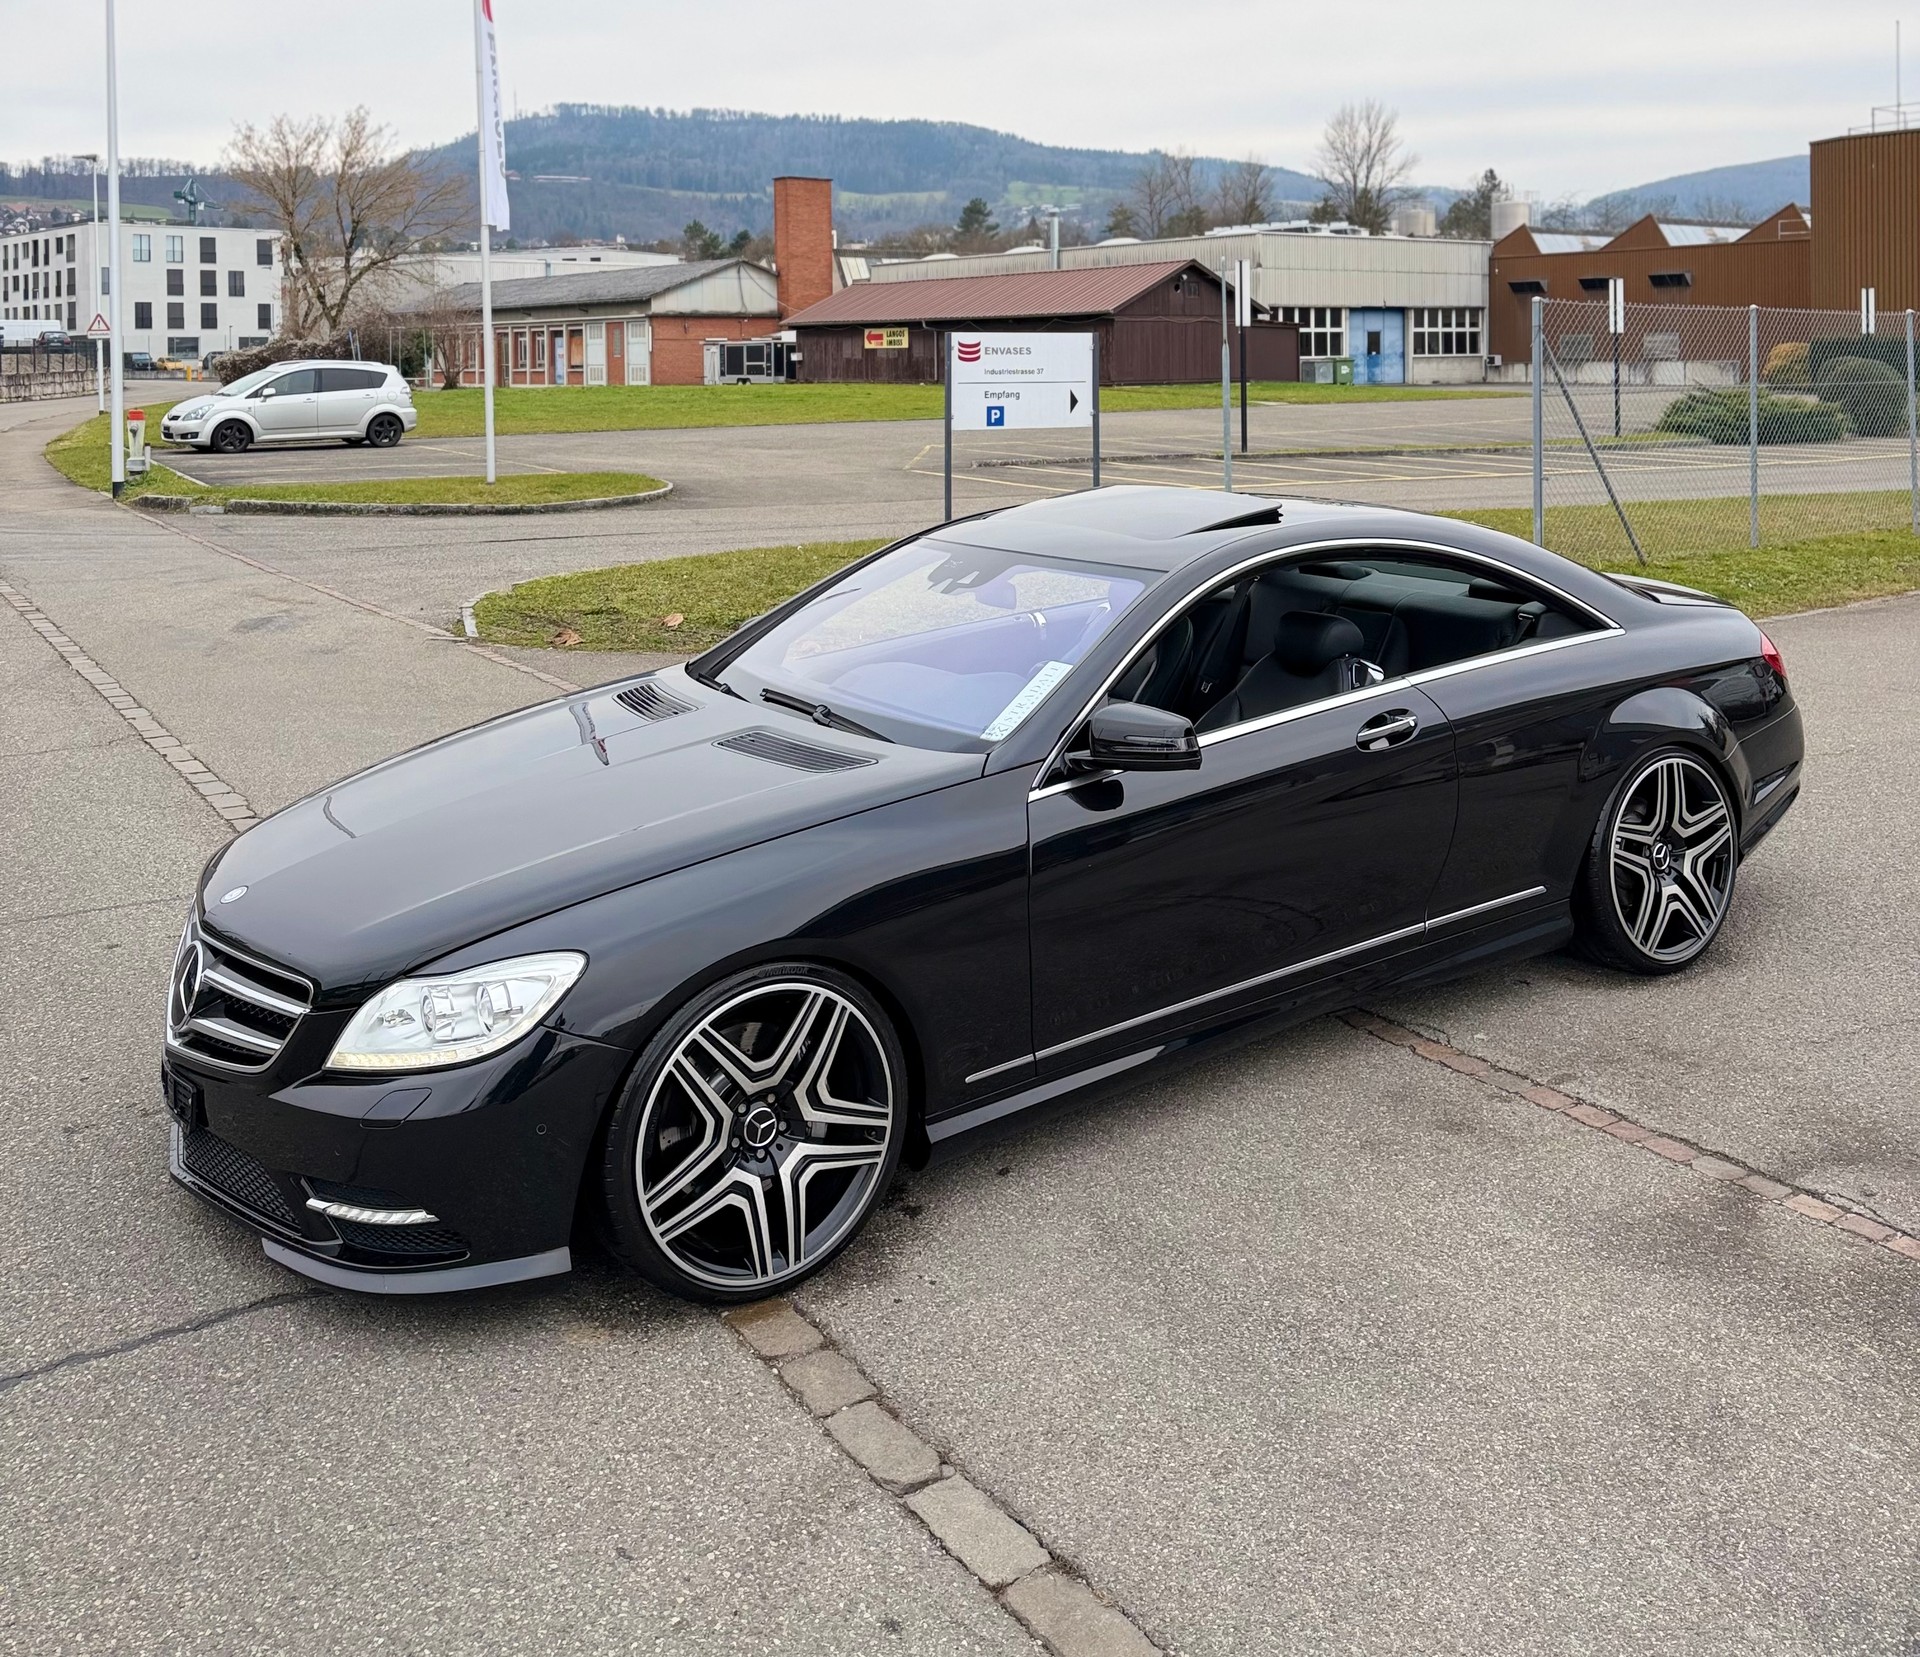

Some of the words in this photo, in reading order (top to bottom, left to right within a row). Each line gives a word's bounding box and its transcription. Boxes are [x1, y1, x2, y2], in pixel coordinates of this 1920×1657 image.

[984, 346, 1032, 356] ENVASES
[984, 368, 1036, 376] Industriestrasse
[1036, 367, 1044, 375] 37
[984, 390, 1021, 401] Empfang
[991, 409, 1001, 424] P
